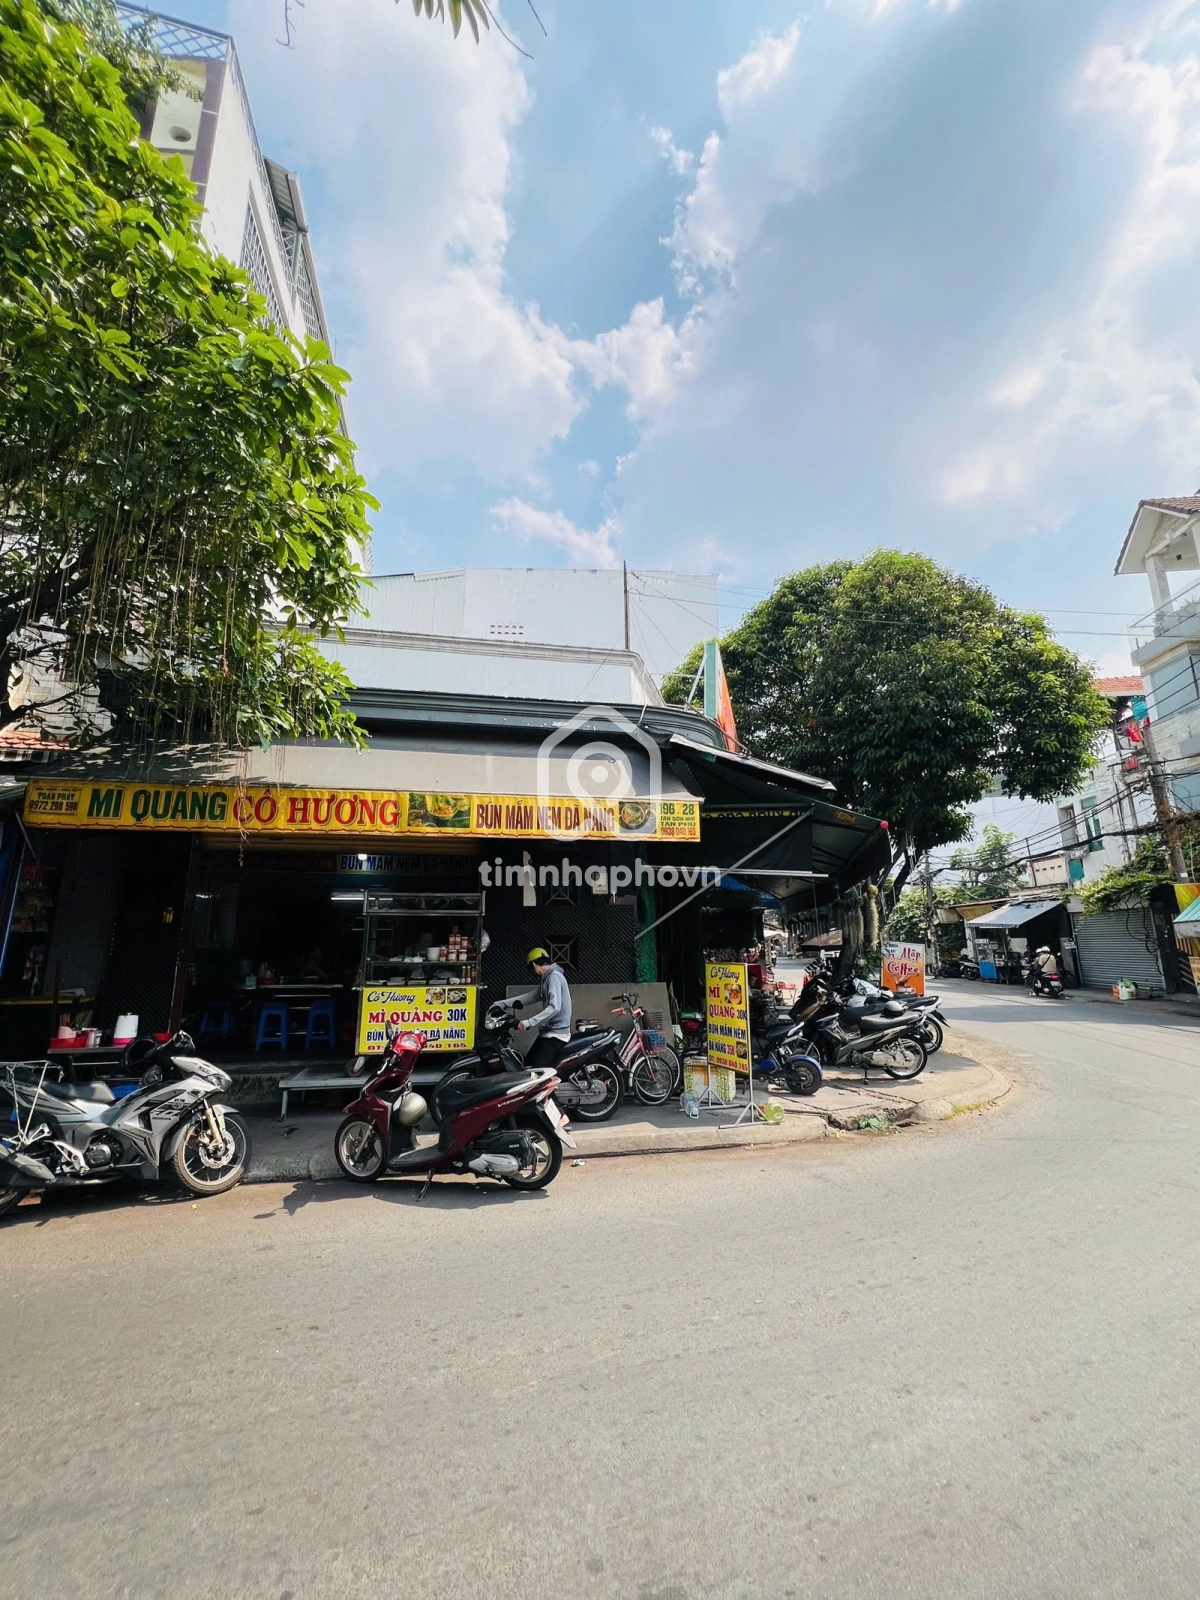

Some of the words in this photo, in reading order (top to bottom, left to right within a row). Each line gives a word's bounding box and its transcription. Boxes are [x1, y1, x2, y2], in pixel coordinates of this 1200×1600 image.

[232, 788, 279, 826] CÔ
[287, 793, 402, 827] HƯƠNG
[475, 801, 502, 830] BÚN
[505, 800, 533, 830] MẮM
[660, 802, 675, 815] 196
[682, 803, 695, 816] 28
[887, 961, 919, 975] Coffee
[709, 984, 720, 999] MÌ
[368, 1009, 386, 1024] MÌ
[389, 1007, 443, 1025] QUẢNG
[447, 1008, 467, 1021] 30K
[367, 1026, 384, 1041] BÚN
